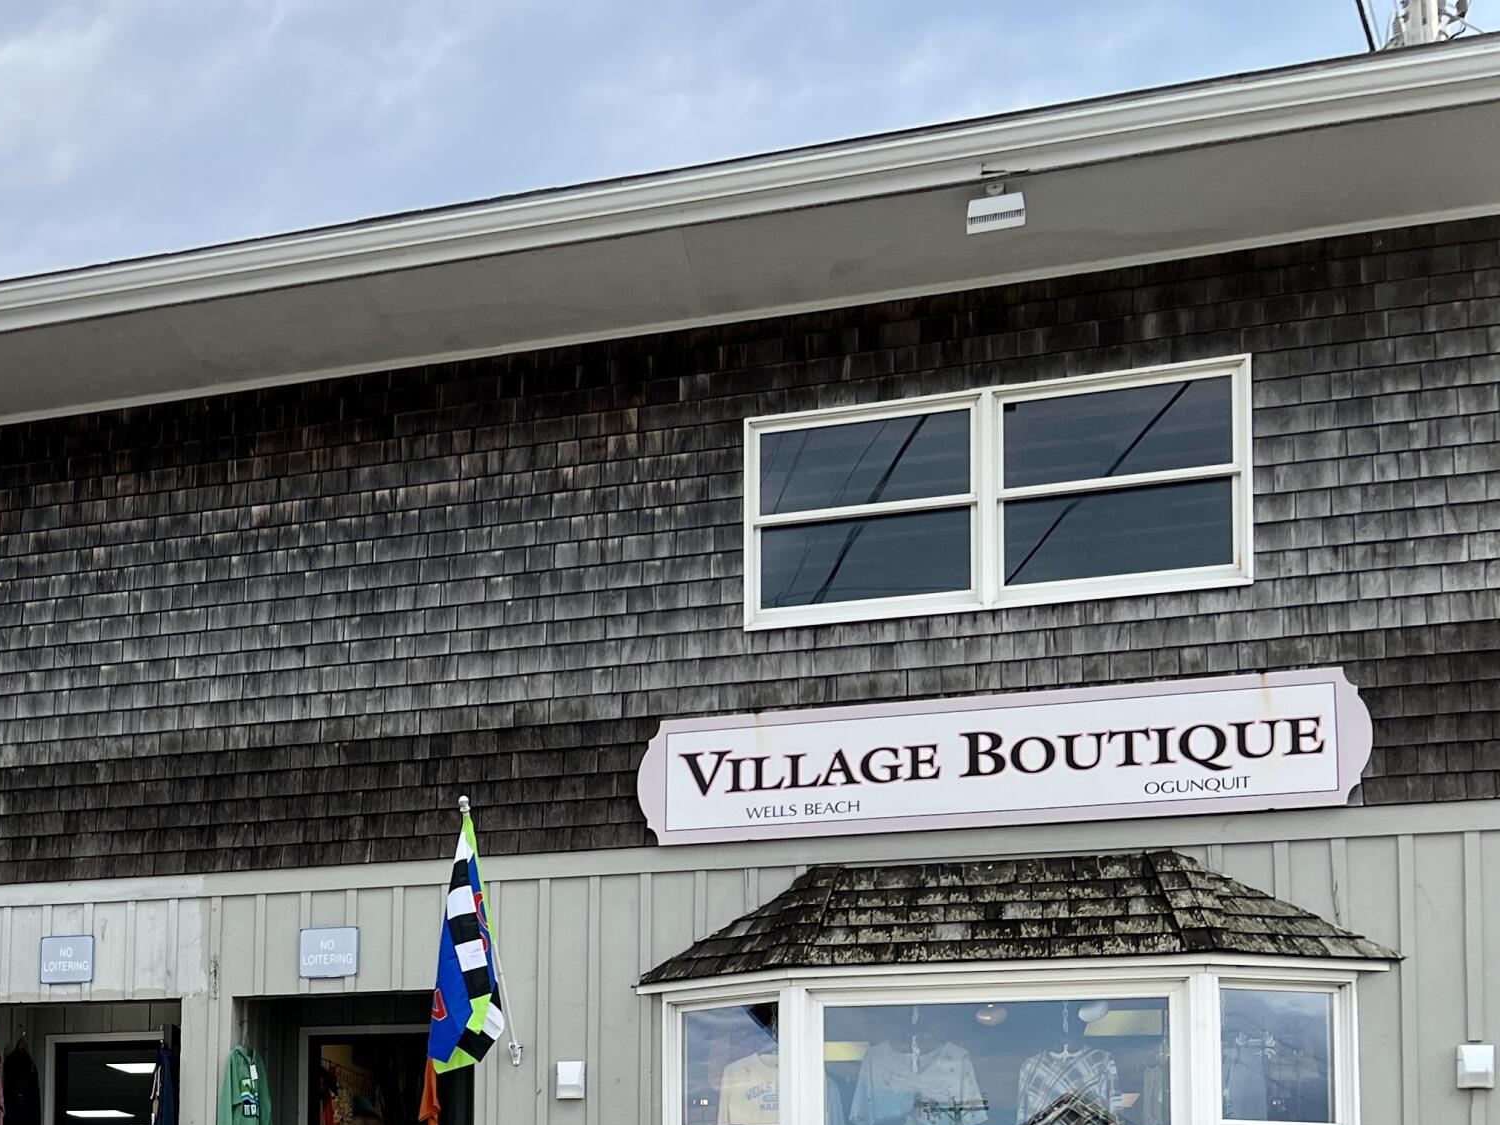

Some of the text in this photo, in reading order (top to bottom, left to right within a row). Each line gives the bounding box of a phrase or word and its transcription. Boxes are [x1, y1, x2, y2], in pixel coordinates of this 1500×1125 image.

[678, 715, 1327, 798] VILLAGE BOUTIQUE
[1143, 775, 1252, 795] OGUNQUIT
[745, 800, 861, 819] WELLS BEACH
[320, 939, 335, 951] NO
[59, 947, 73, 958] NO
[43, 960, 89, 972] LOITERING
[302, 953, 353, 966] LOITERING
